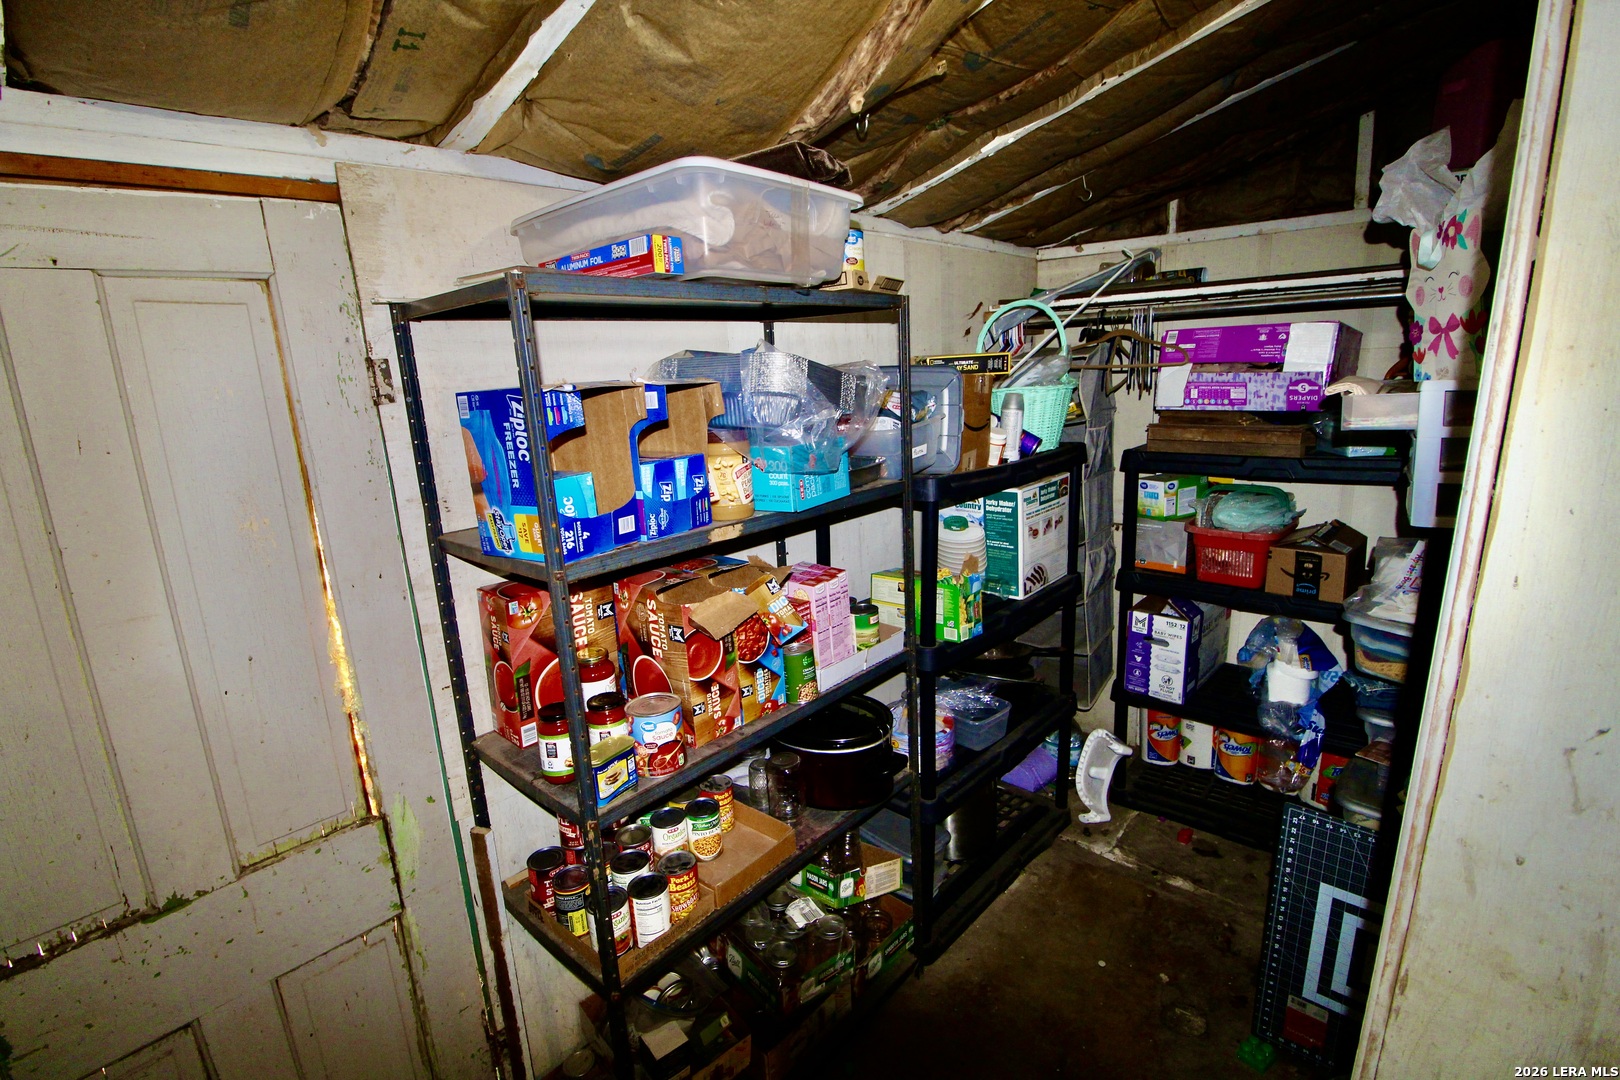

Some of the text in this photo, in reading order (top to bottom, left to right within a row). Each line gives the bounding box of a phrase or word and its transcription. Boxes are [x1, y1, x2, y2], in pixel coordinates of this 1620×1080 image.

[590, 256, 603, 265] FOIL
[510, 399, 531, 463] Ziploc
[503, 422, 519, 488] FREEZER
[769, 460, 787, 472] 300
[661, 484, 672, 502] Zip
[563, 496, 575, 517] loc
[534, 522, 542, 548] QUART
[565, 530, 575, 549] 216
[1295, 587, 1317, 595] prime
[770, 596, 789, 613] DIC
[570, 592, 588, 651] SAUCE
[585, 597, 595, 634] TOMATO
[490, 615, 500, 650] SAUCE
[646, 599, 663, 658] SAUCE
[657, 612, 668, 651] TOMATO
[757, 669, 766, 702] DICED
[711, 683, 722, 719] SAUCE
[652, 732, 674, 741] Sauce
[1223, 743, 1252, 753] Towels
[714, 792, 728, 800] Pork
[669, 877, 696, 891] Beans
[670, 875, 689, 884] Pork
[806, 872, 828, 887] MASON JARS
[671, 893, 699, 912] SHOWBOAT
